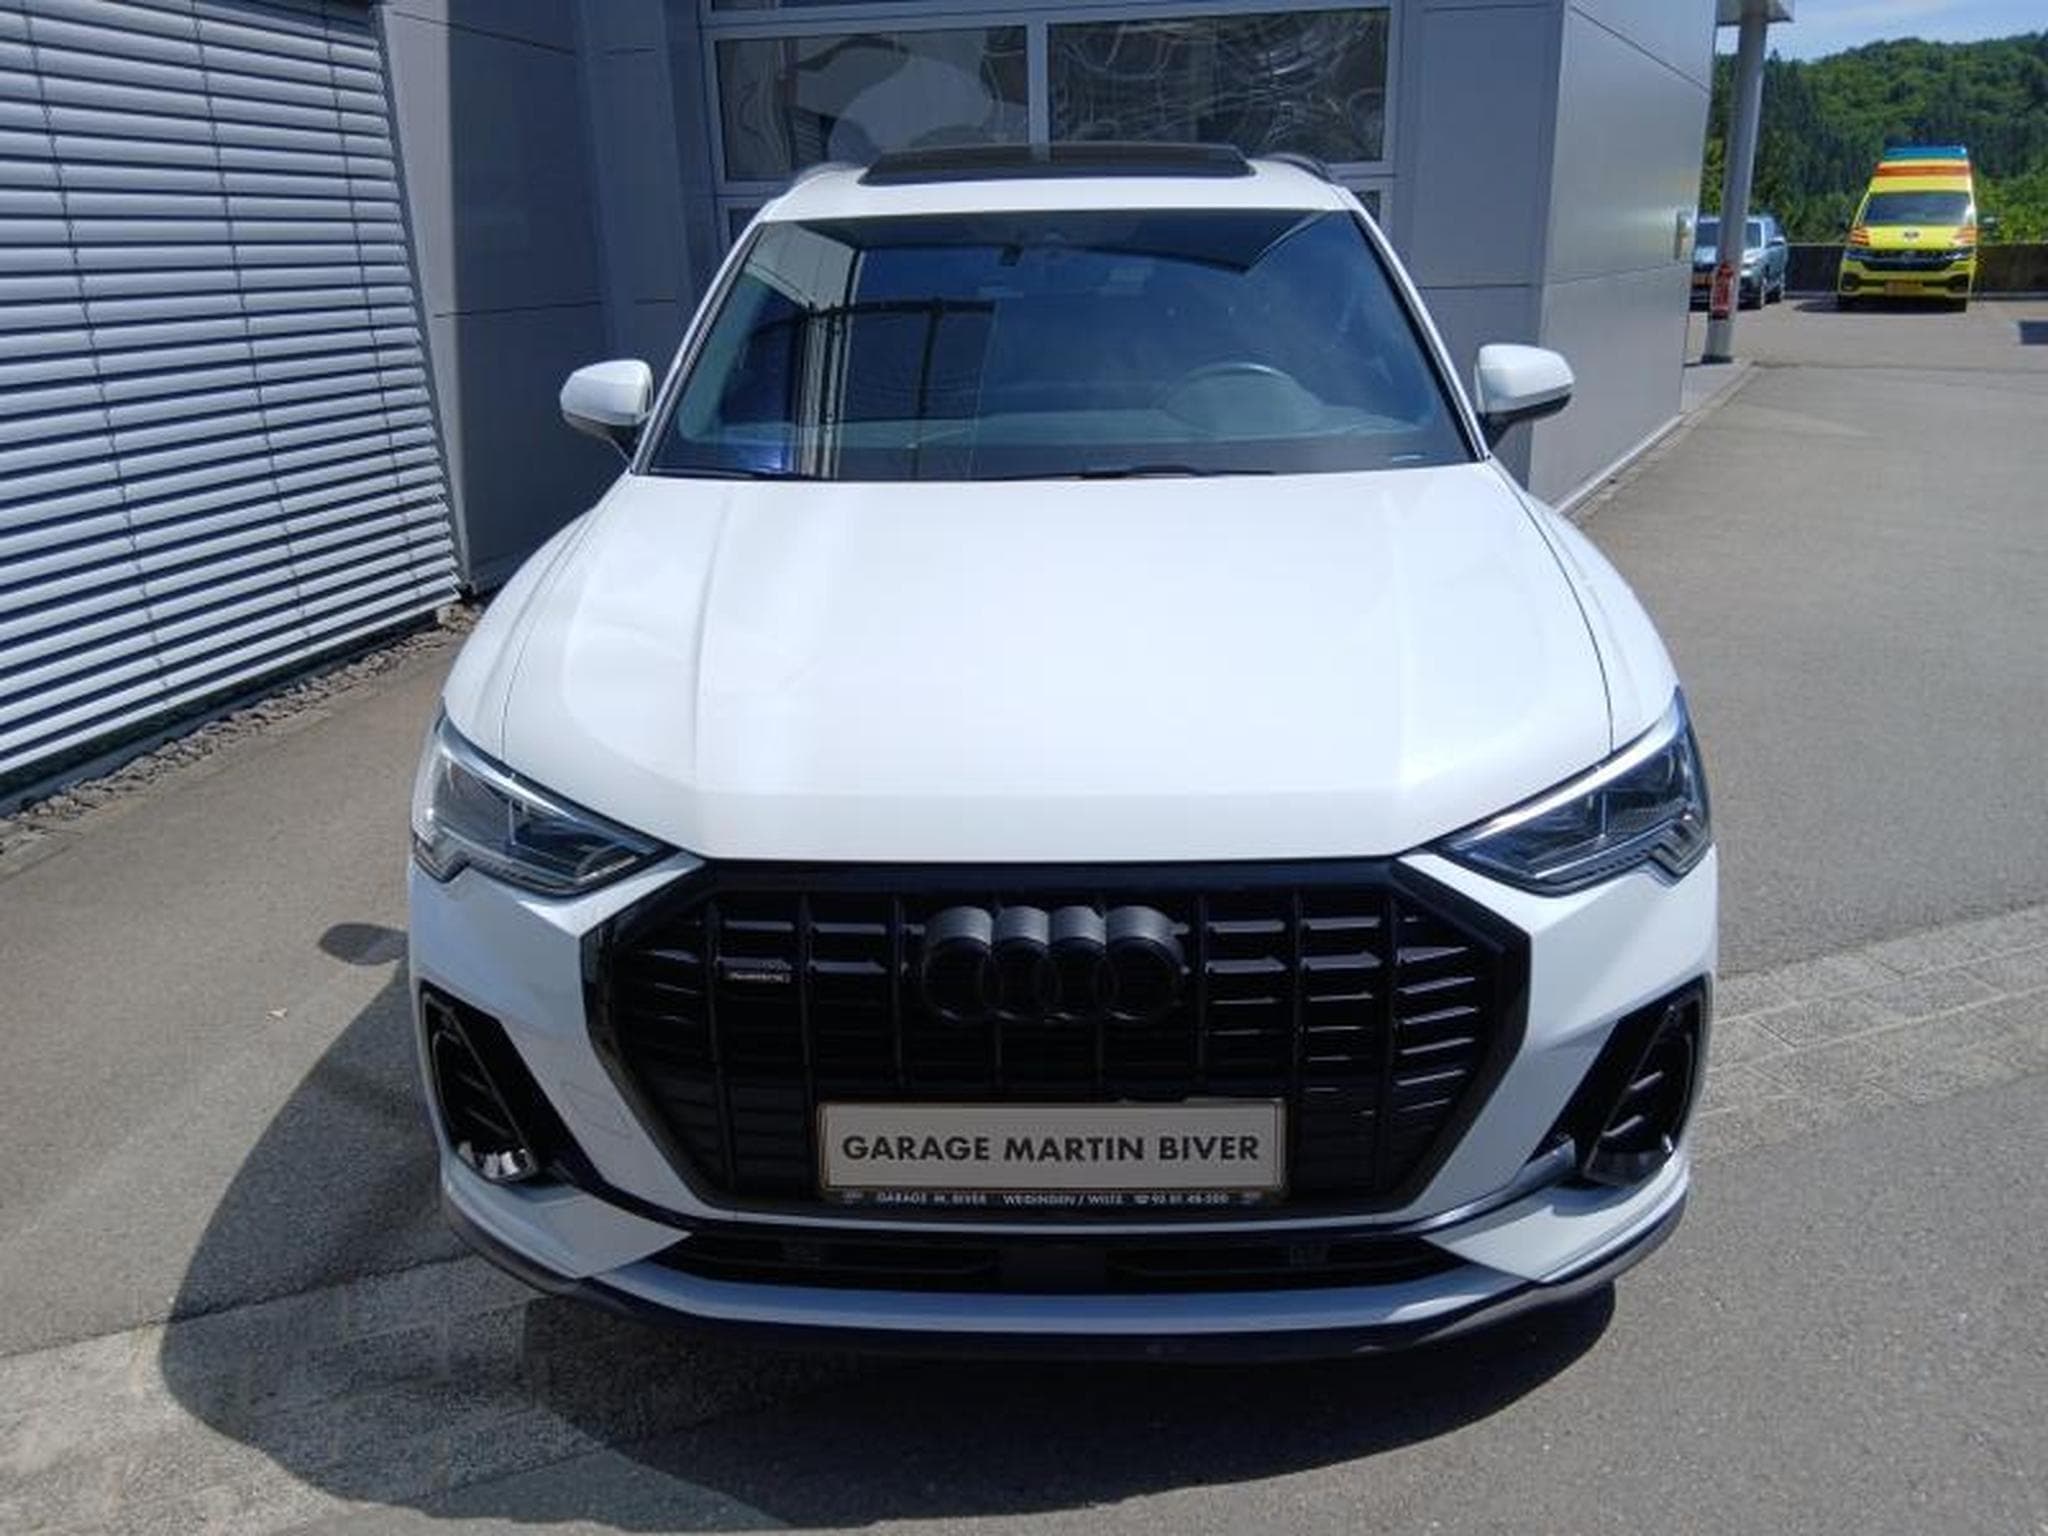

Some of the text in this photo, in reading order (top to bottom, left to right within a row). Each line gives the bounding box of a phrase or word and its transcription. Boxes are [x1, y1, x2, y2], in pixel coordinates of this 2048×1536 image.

[842, 1134, 1260, 1161] GARAGE MARTIN BIVER
